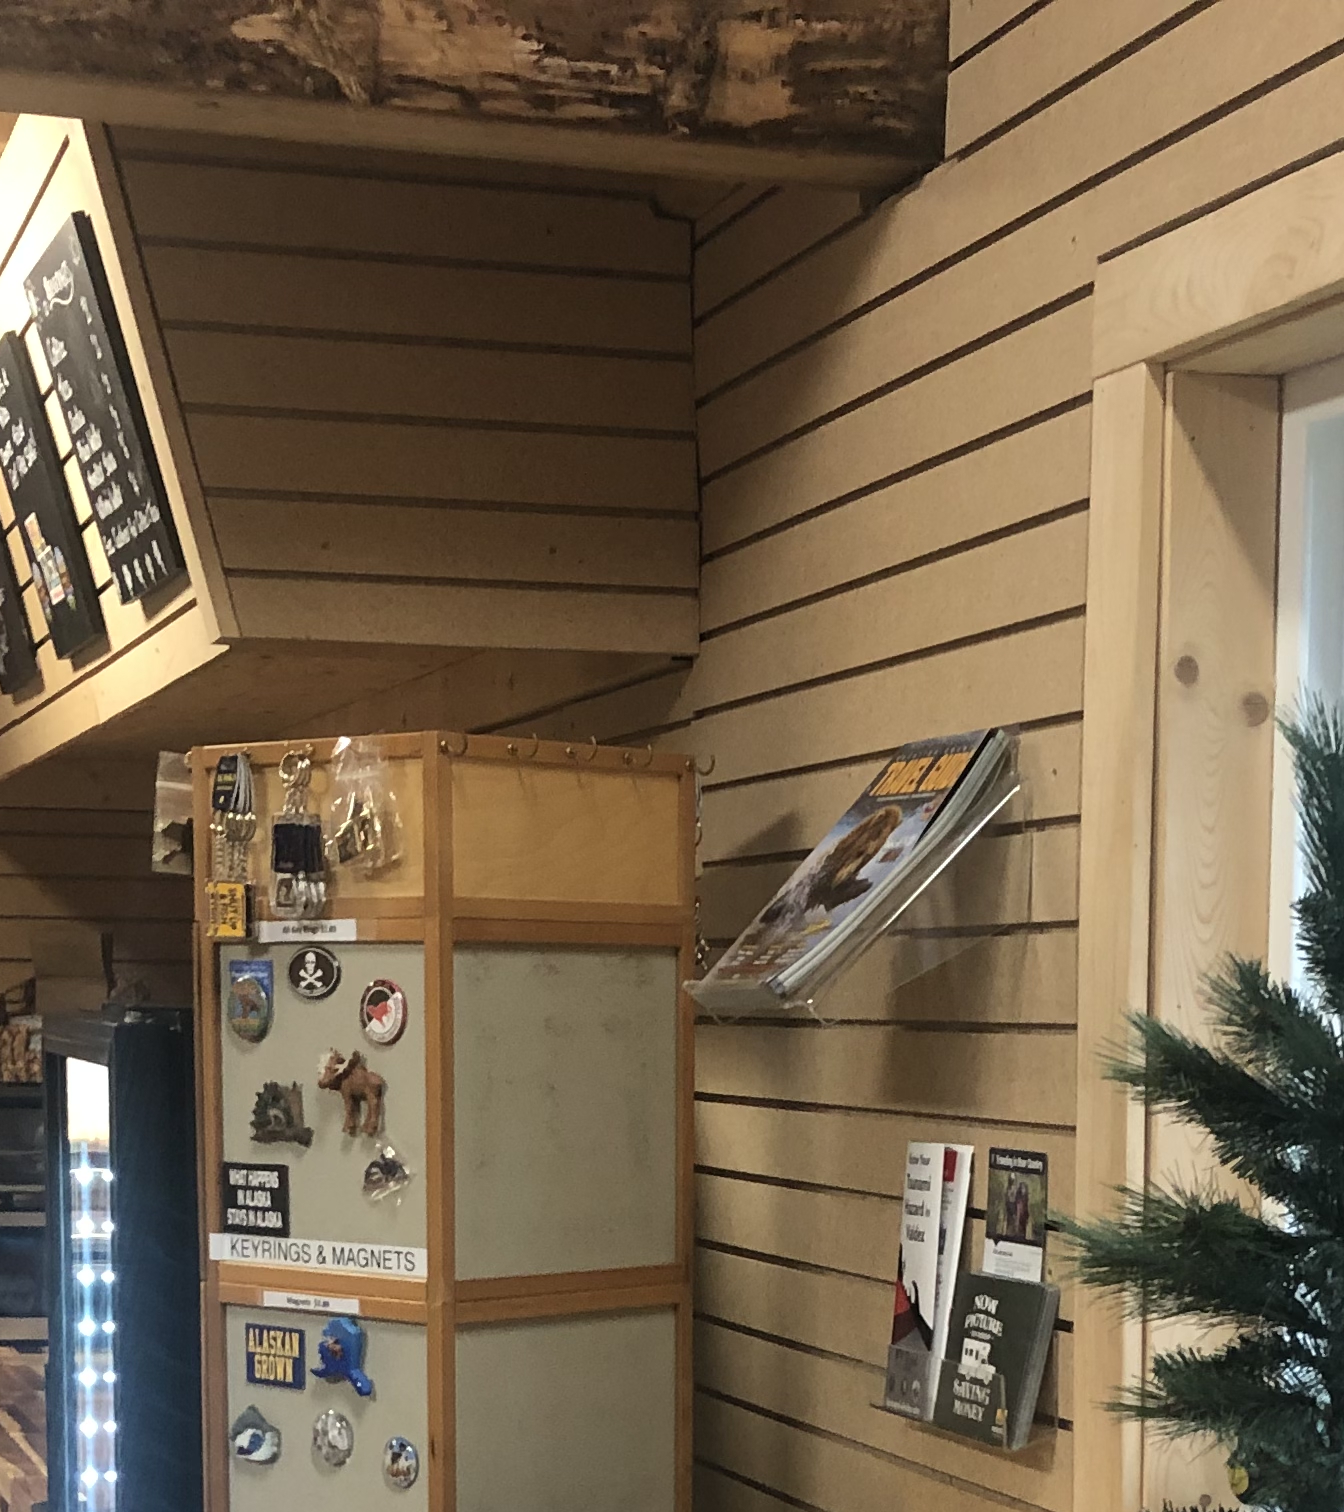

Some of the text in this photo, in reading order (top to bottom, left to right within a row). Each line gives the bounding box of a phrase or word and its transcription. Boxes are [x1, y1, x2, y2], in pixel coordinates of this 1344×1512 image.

[230, 1237, 416, 1272] KEYRINGS & MAGNETS
[974, 1294, 999, 1315] NOW
[964, 1313, 1004, 1337] PICTURE
[248, 1327, 300, 1358] ALASKAN
[254, 1354, 293, 1382] GROWN
[953, 1378, 991, 1405] SAVING
[953, 1399, 985, 1422] MONEY
